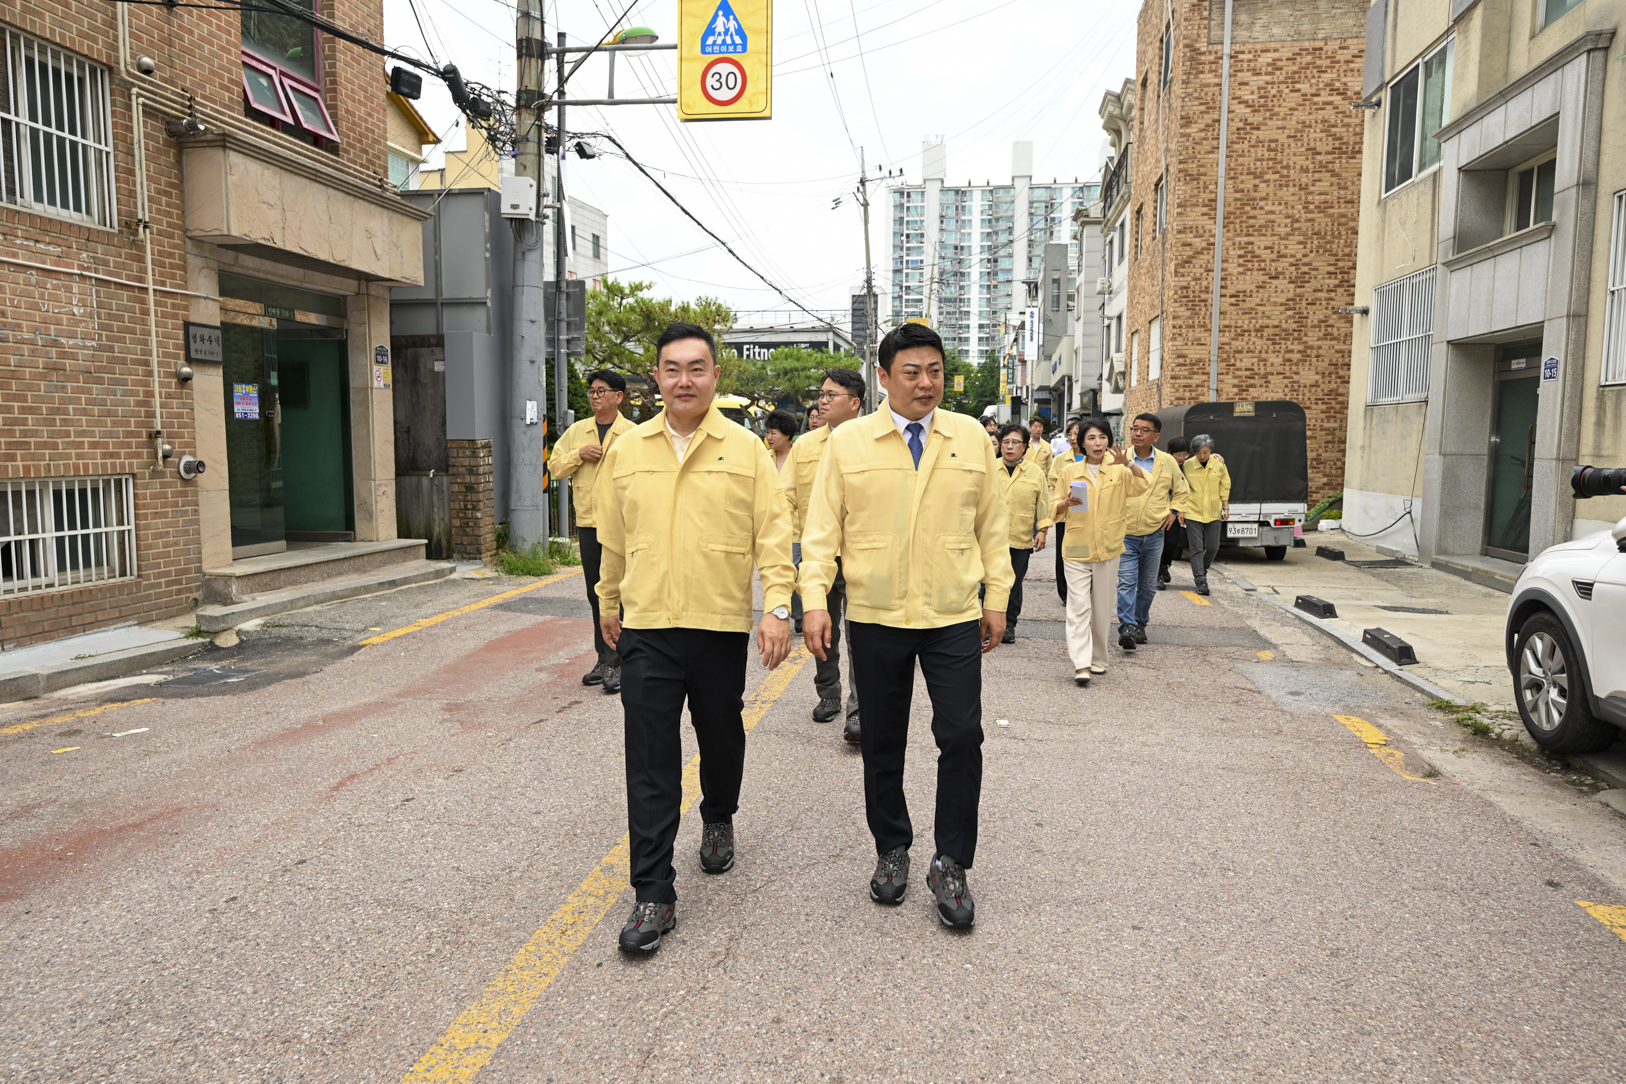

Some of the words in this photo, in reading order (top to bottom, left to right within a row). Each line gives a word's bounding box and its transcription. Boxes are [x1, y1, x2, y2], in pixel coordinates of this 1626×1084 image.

[710, 71, 738, 91] 30
[1544, 368, 1557, 378] 10-15
[246, 385, 258, 394] 부동산
